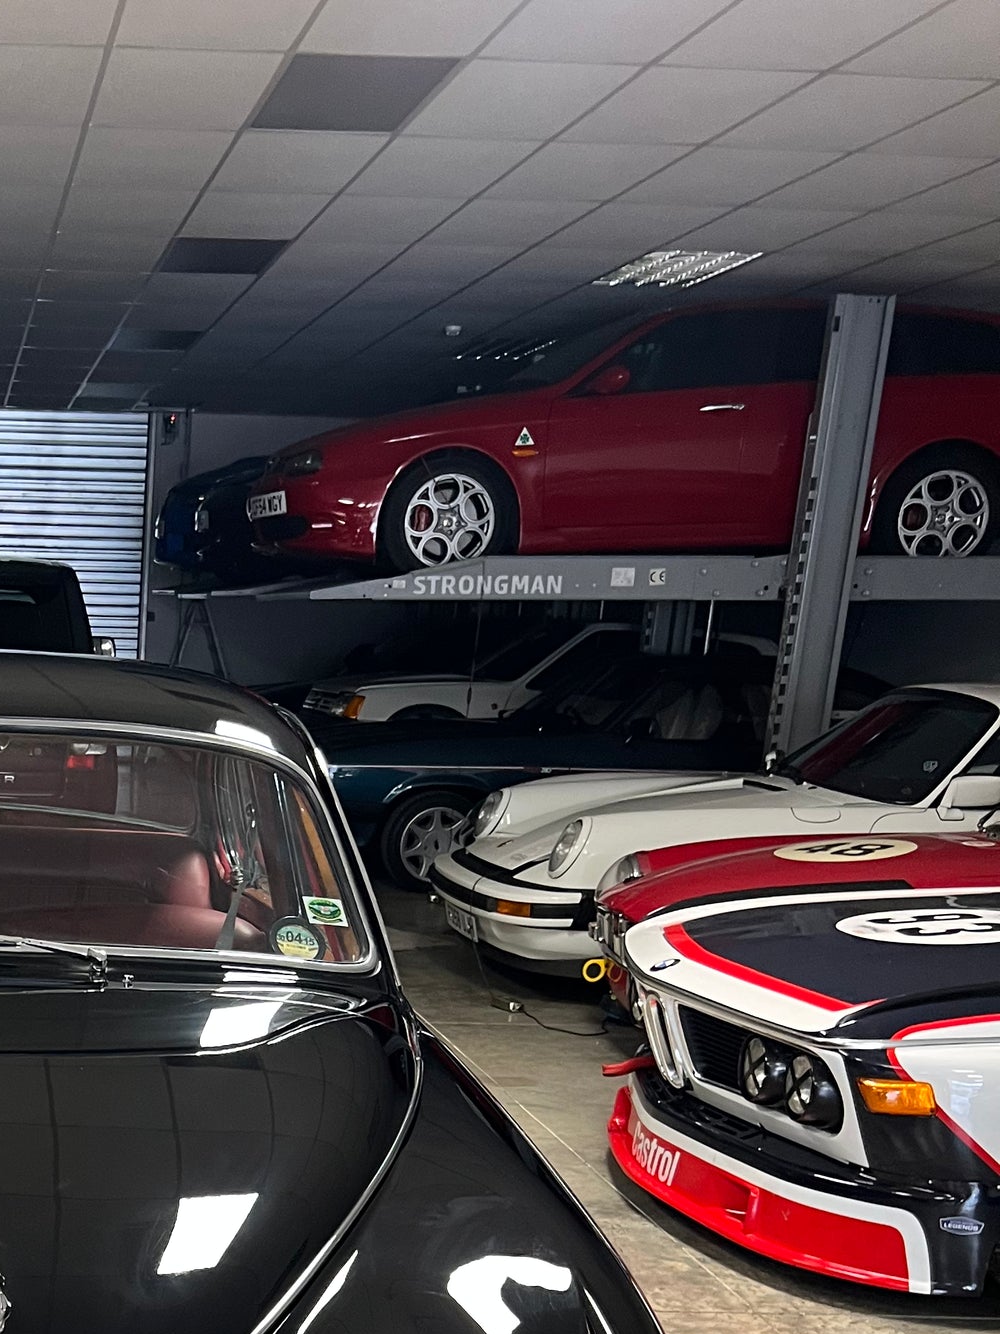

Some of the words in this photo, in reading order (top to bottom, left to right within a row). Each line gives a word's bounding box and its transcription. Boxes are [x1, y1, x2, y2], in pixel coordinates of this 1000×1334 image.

[412, 574, 563, 595] STRONGMAN
[794, 842, 896, 857] 48
[632, 1121, 681, 1187] Castrol
